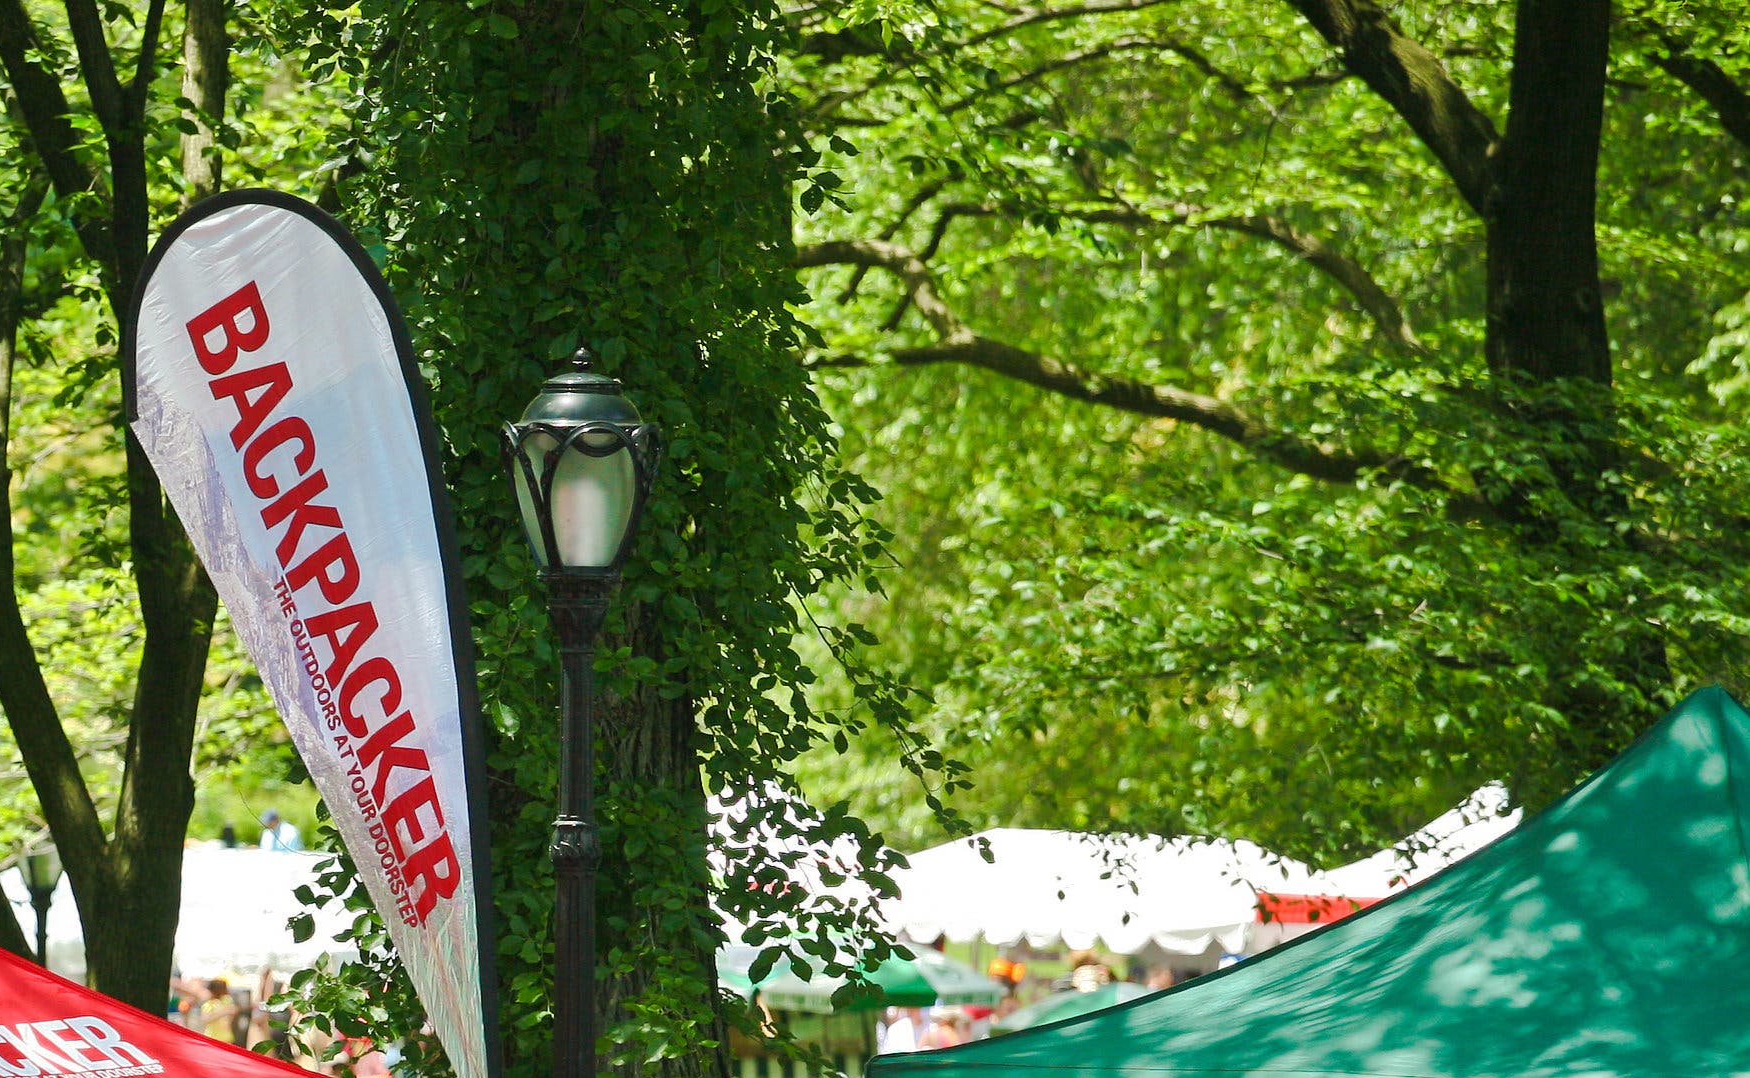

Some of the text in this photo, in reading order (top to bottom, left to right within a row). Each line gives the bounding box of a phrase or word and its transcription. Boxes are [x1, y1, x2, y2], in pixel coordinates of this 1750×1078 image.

[186, 281, 461, 930] BACKPACKER
[274, 576, 419, 929] THE OUTDOORS AT YOUR DOORSTEP
